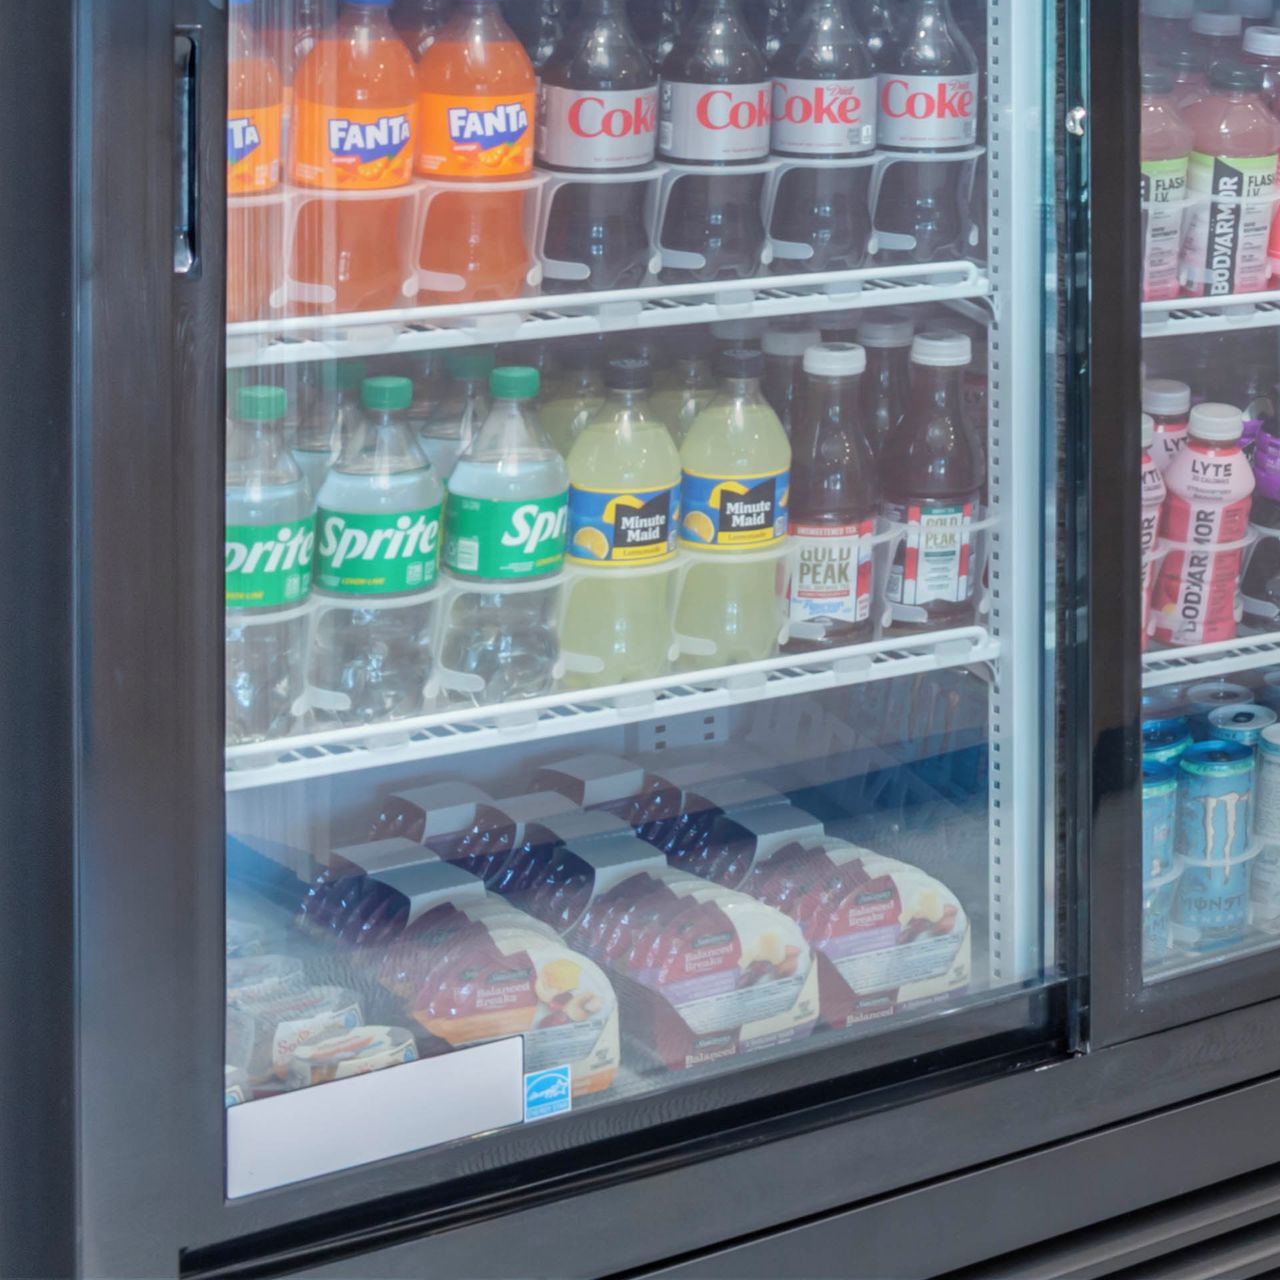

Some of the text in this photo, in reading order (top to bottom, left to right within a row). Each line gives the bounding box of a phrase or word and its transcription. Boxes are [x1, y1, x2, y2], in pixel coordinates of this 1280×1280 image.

[880, 78, 974, 120] Coke
[448, 102, 529, 139] FANTA
[328, 115, 411, 151] FANTA
[1211, 176, 1240, 296] BODYARMOR
[1191, 459, 1233, 477] LYTE
[726, 499, 771, 516] Minute
[620, 514, 666, 531] Minute
[731, 513, 765, 528] Maid
[319, 515, 439, 568] Sprite
[626, 526, 660, 543] Maid
[799, 562, 850, 585] PEAK
[476, 981, 530, 999] Balanced
